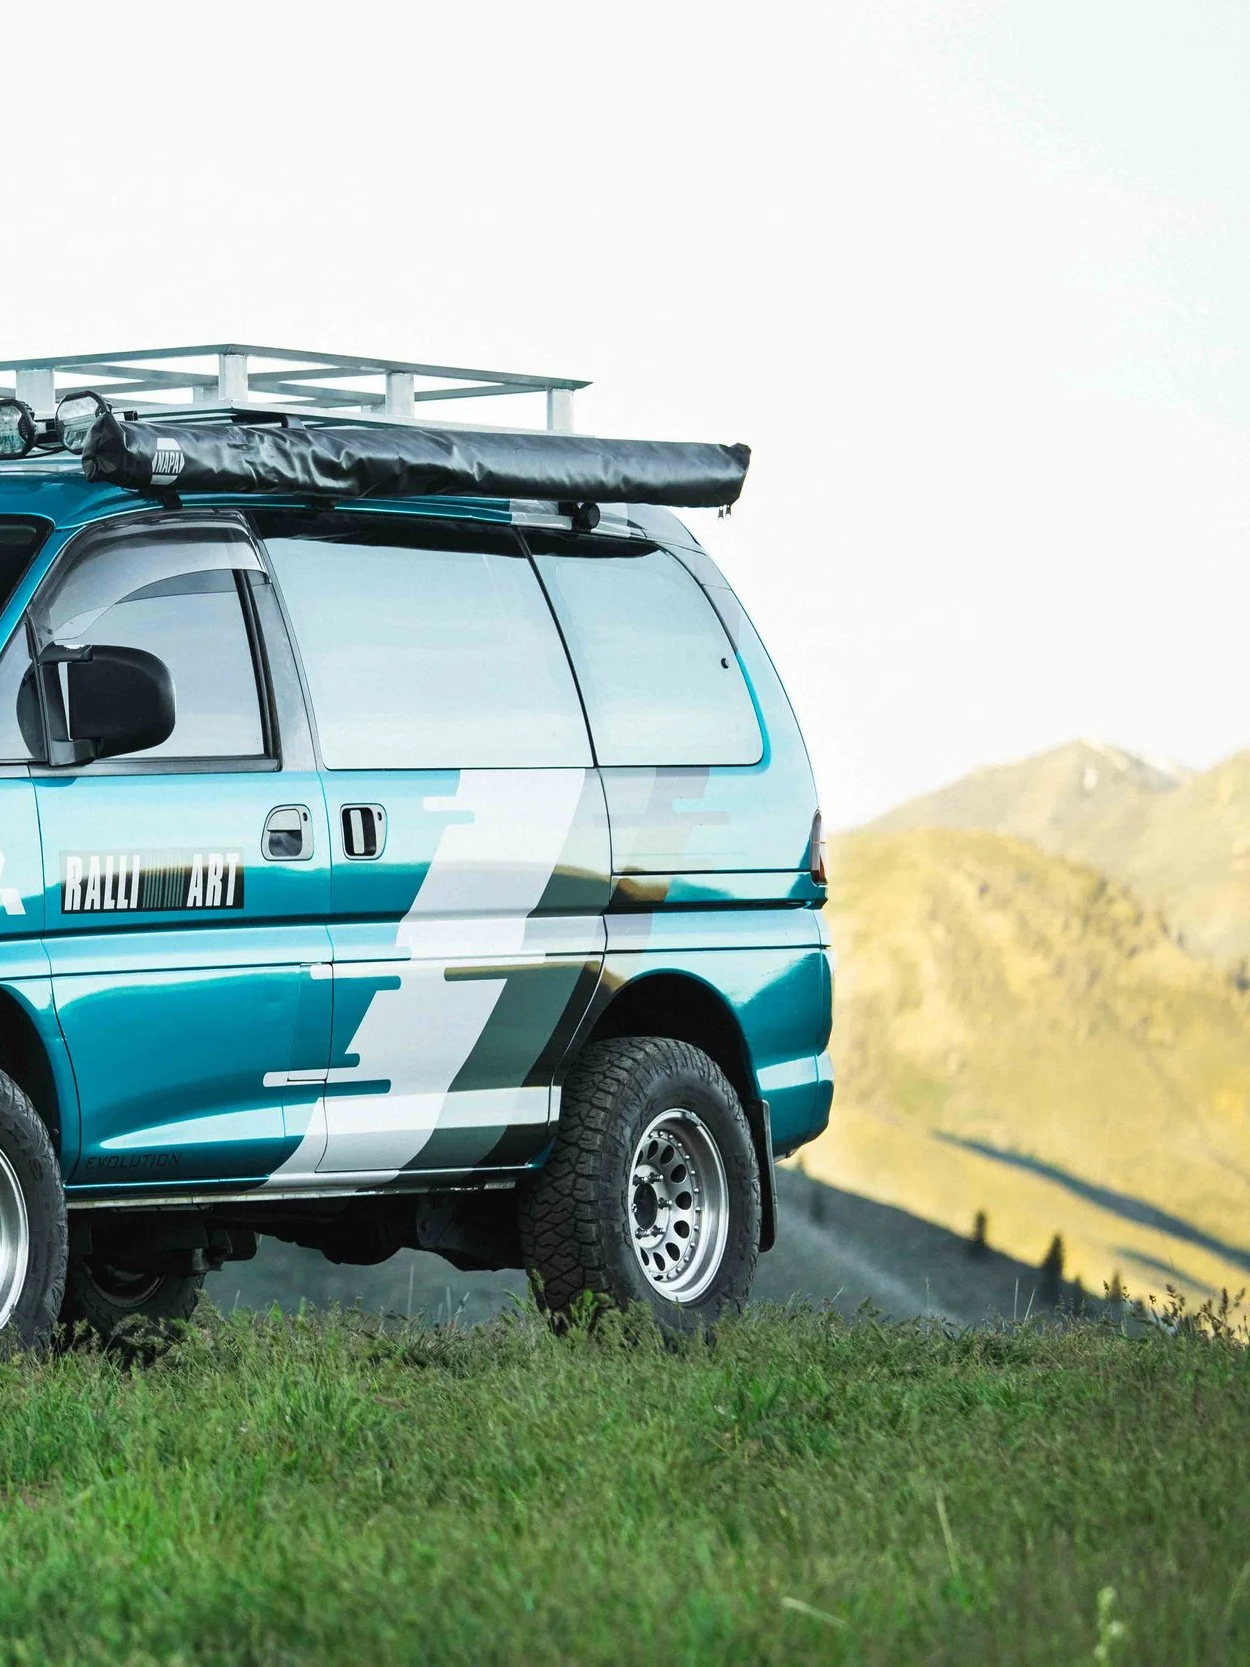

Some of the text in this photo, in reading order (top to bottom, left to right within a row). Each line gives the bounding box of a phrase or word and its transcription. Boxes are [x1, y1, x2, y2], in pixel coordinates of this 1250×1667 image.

[155, 452, 179, 473] NAPA
[64, 853, 240, 911] RALLI ART
[86, 1153, 183, 1169] EVOLUTION
